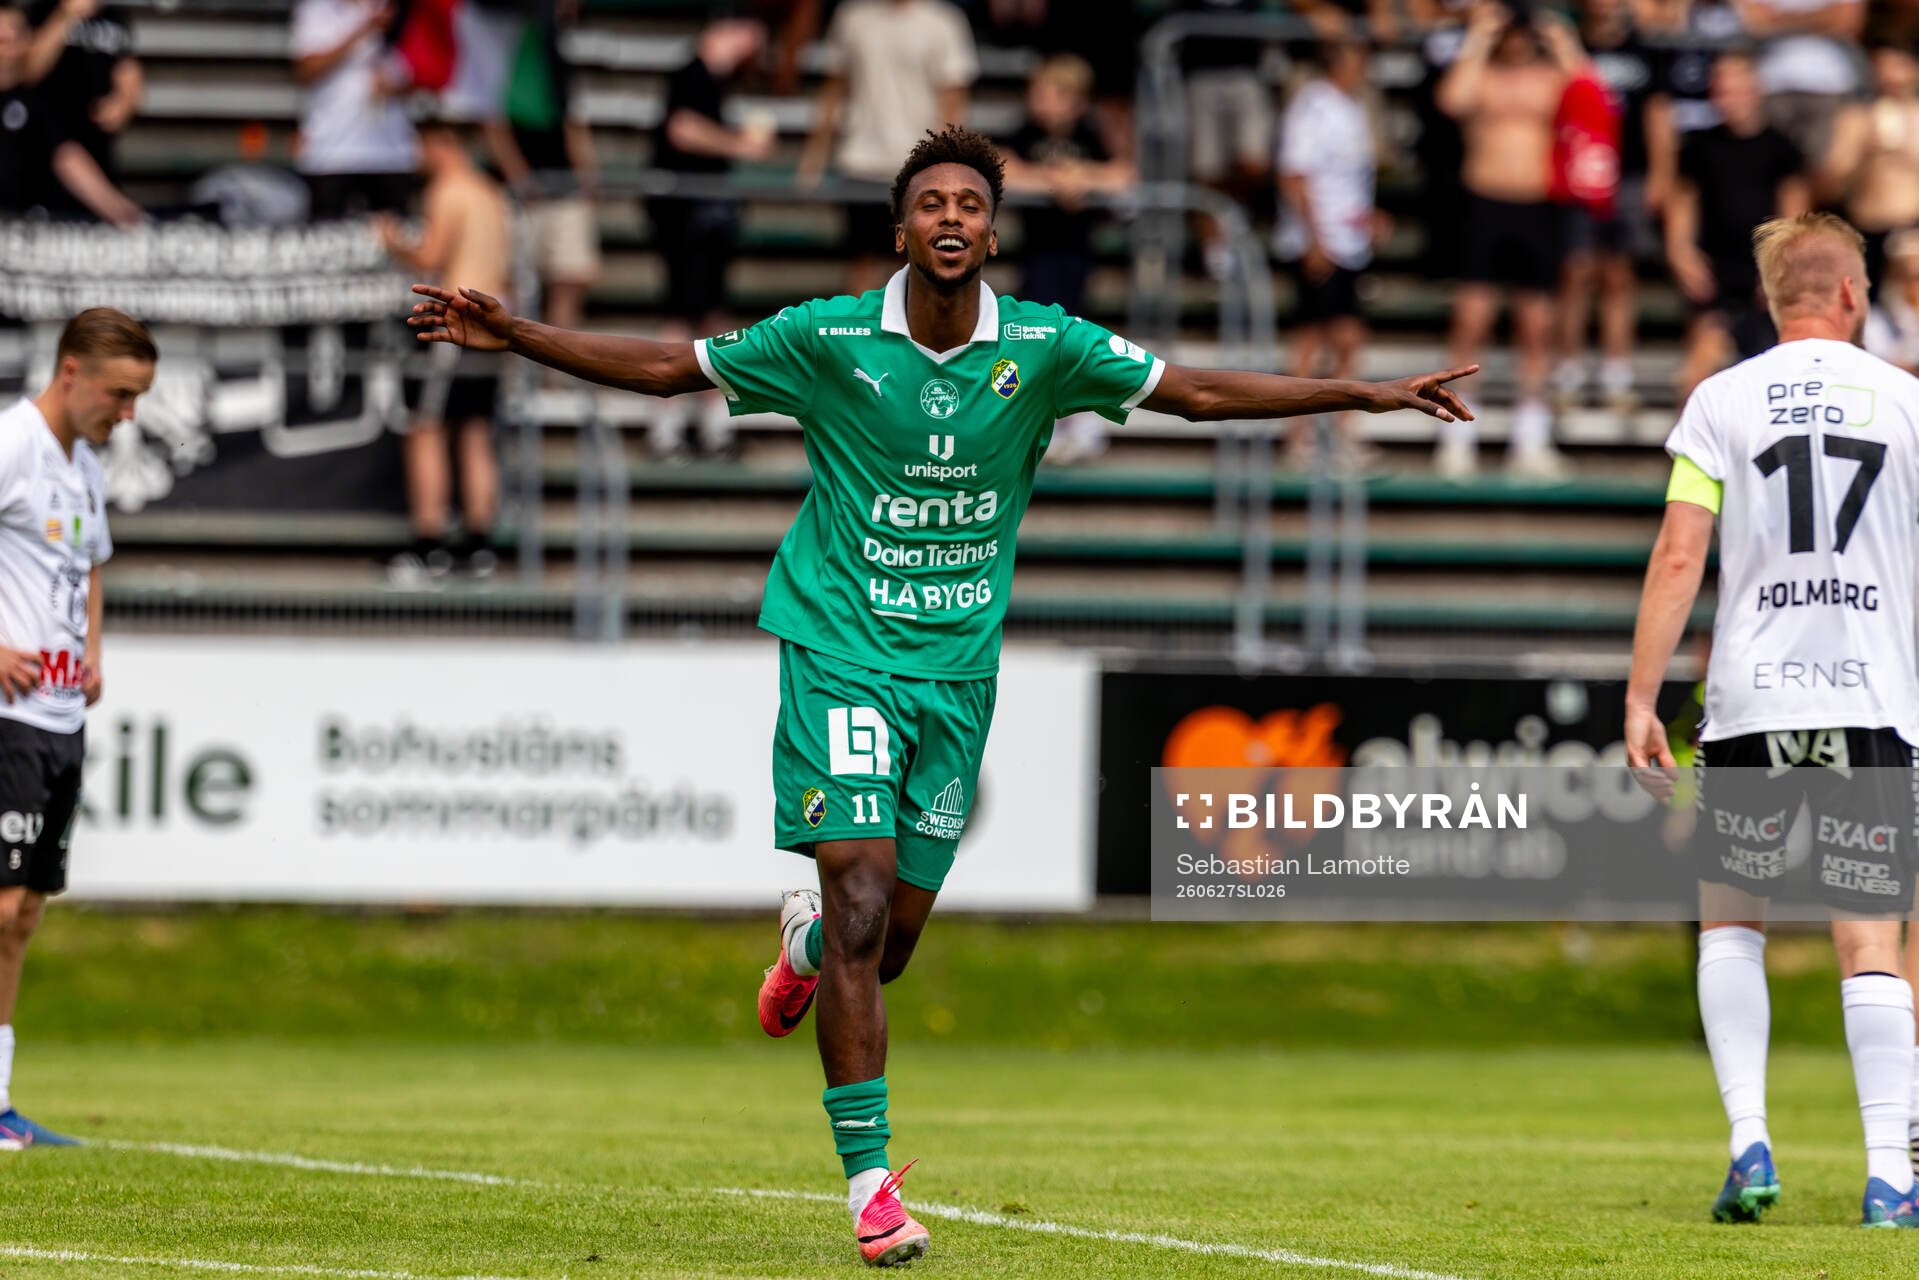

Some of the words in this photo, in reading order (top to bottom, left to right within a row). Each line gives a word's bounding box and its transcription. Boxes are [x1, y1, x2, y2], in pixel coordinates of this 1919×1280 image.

[830, 327, 871, 336] BILLES
[1768, 381, 1823, 405] pre
[1769, 405, 1844, 424] zero
[905, 462, 977, 481] unisport
[1753, 434, 1888, 554] 17
[872, 491, 997, 527] renta
[864, 537, 923, 567] Dala
[926, 540, 998, 567] Trähus
[869, 578, 917, 608] H.A
[922, 578, 992, 610] BYGG
[1754, 659, 1869, 689] ERNST
[852, 794, 881, 823] 11
[916, 821, 961, 839] CONCRET
[1817, 814, 1898, 853] EXACT
[1822, 853, 1890, 879] NORDIC
